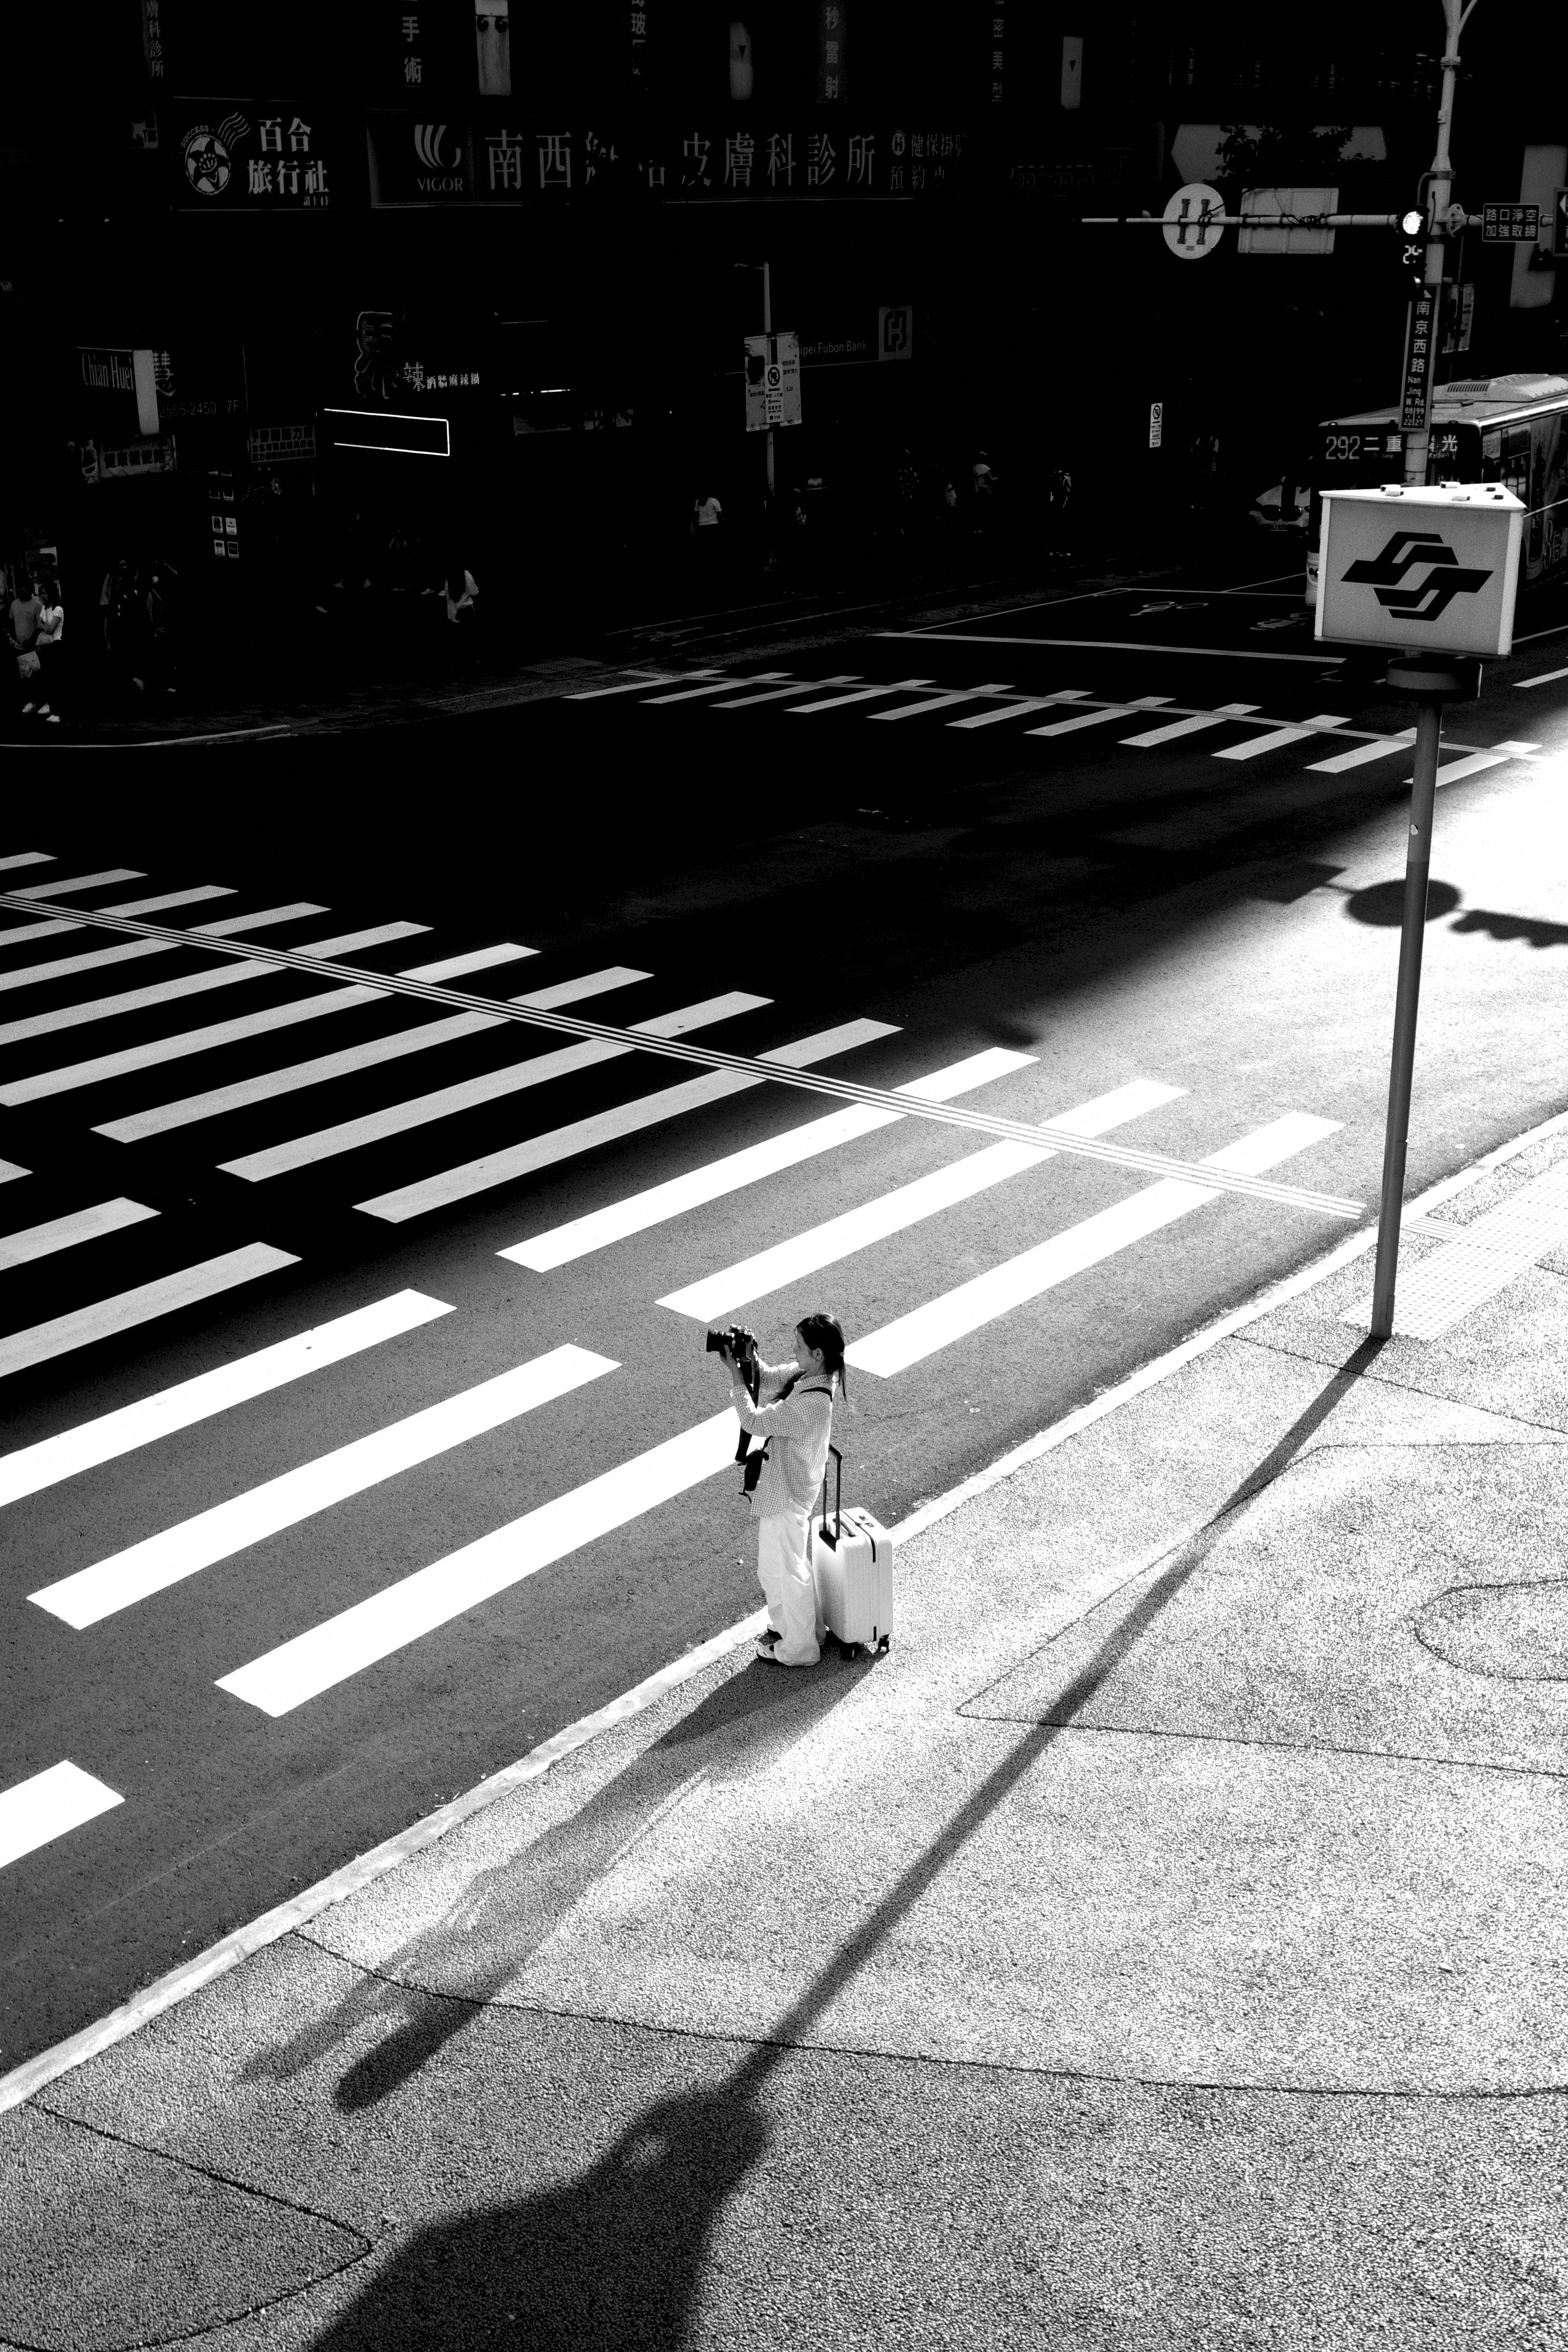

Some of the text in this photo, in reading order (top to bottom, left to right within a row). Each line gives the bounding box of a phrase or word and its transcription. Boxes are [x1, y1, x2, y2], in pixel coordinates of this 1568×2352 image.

[402, 16, 422, 83] 手術
[991, 0, 1004, 102] 密美型
[181, 125, 209, 148] SUCCESS
[258, 117, 312, 152] 百合
[485, 129, 875, 190] 南西皮膚科診所
[247, 159, 330, 194] 旅行社
[417, 178, 463, 191] VIGOR
[1486, 209, 1537, 221] 路口淨空
[1486, 225, 1536, 237] 加強取締
[1411, 301, 1431, 373] 南京西路
[800, 340, 866, 358] ipei Fubon Bank
[82, 353, 135, 390] Chian Huei
[1408, 376, 1421, 384] Nan
[1406, 387, 1421, 397] Jing
[159, 399, 239, 417] 2555-2450 7F
[1326, 436, 1360, 460] 292
[1363, 435, 1402, 452] 二重
